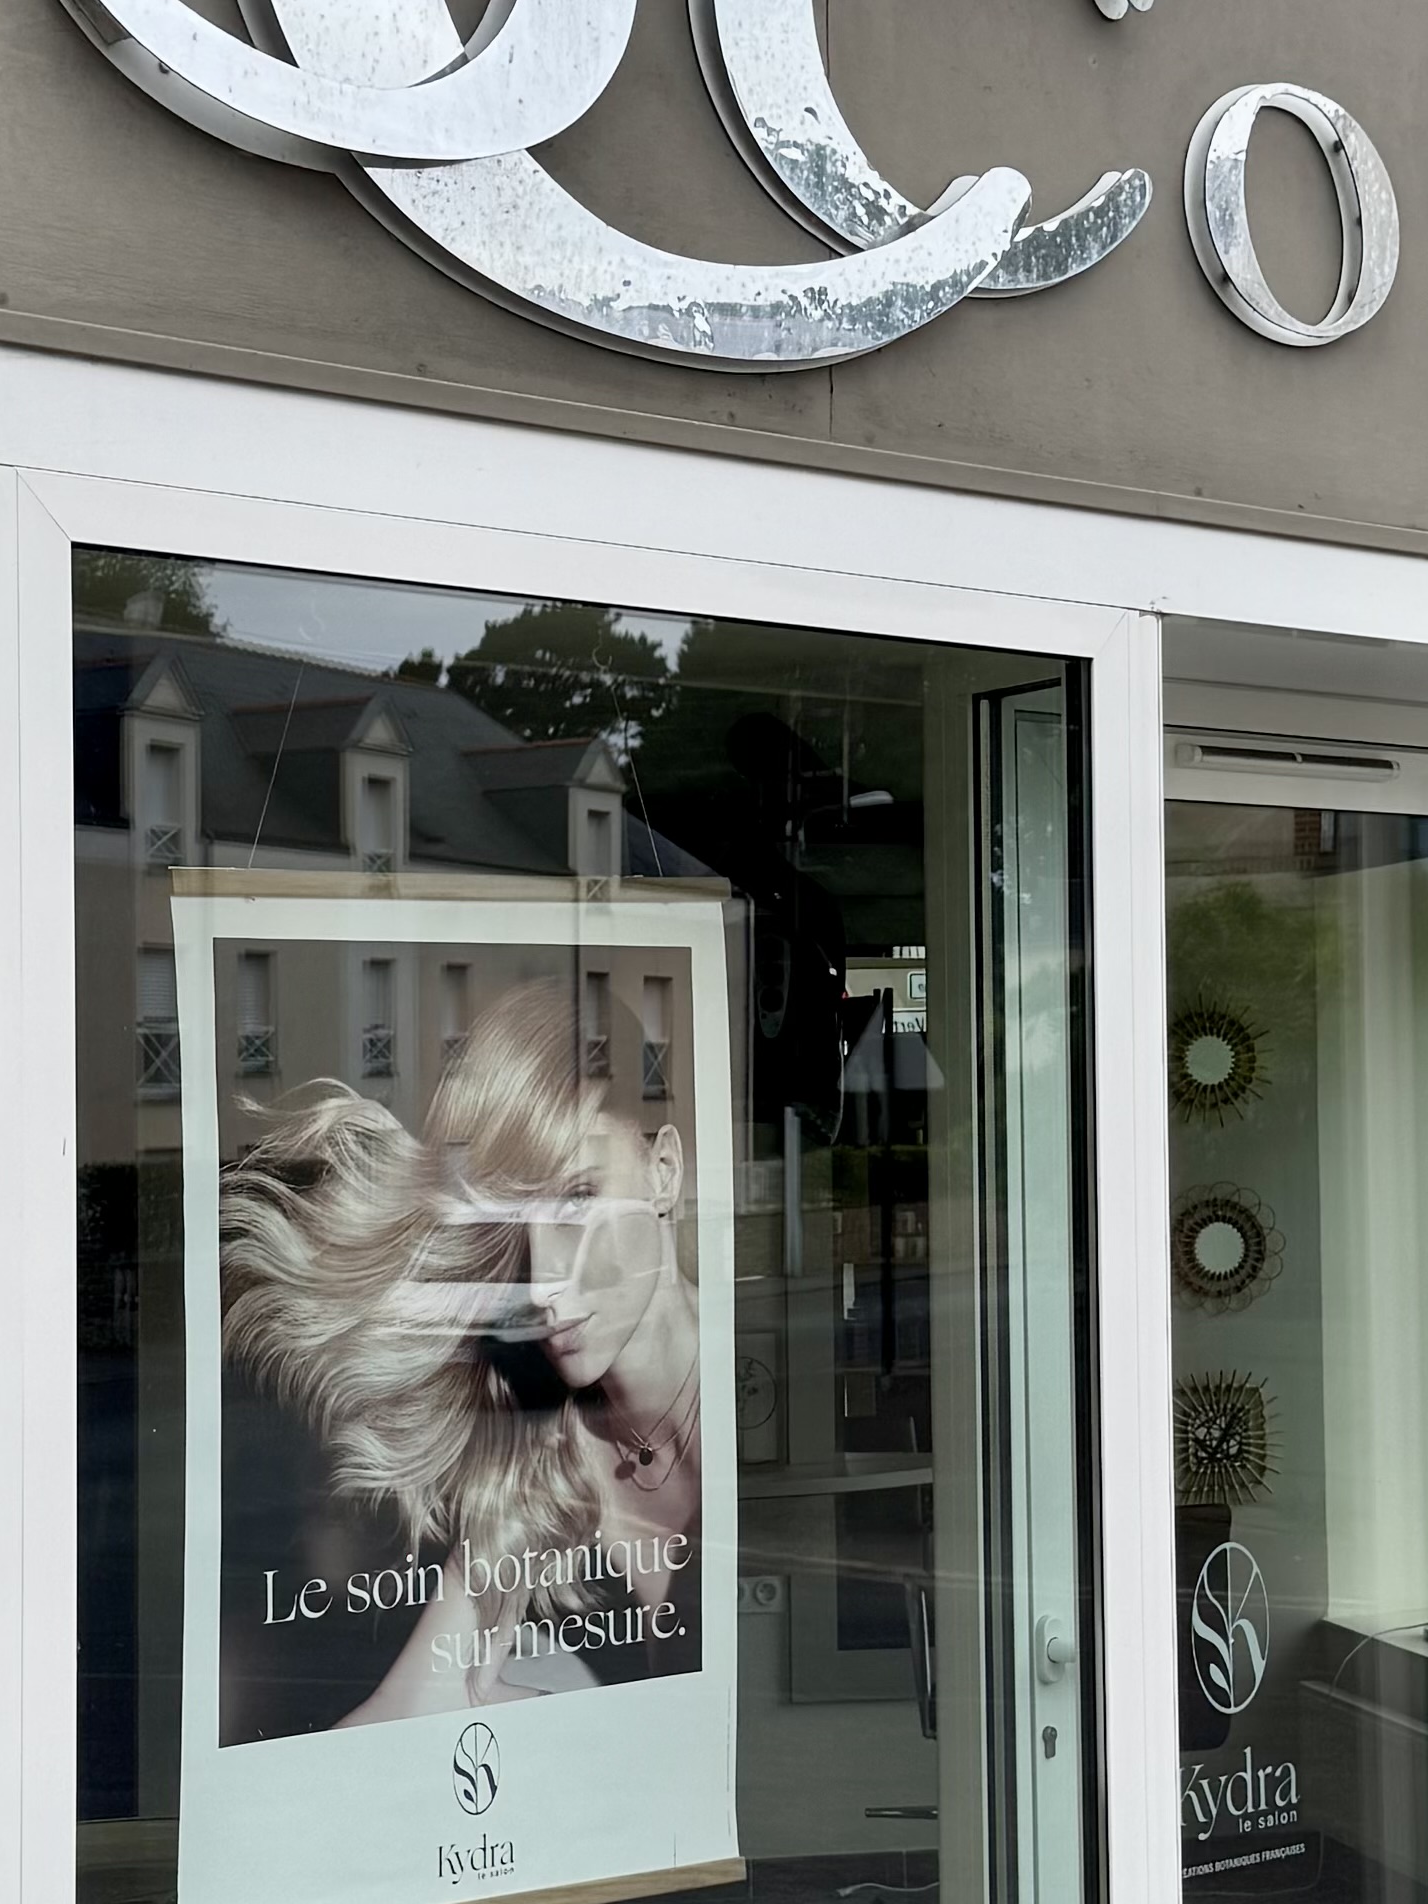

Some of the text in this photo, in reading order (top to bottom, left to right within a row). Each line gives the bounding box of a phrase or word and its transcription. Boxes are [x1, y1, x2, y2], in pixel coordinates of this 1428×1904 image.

[262, 1529, 694, 1625] Le soin botanique
[430, 1598, 688, 1676] sur-mesure.
[1179, 1745, 1301, 1841] Kydra
[1237, 1809, 1299, 1833] le salon
[436, 1833, 515, 1885] Kydra
